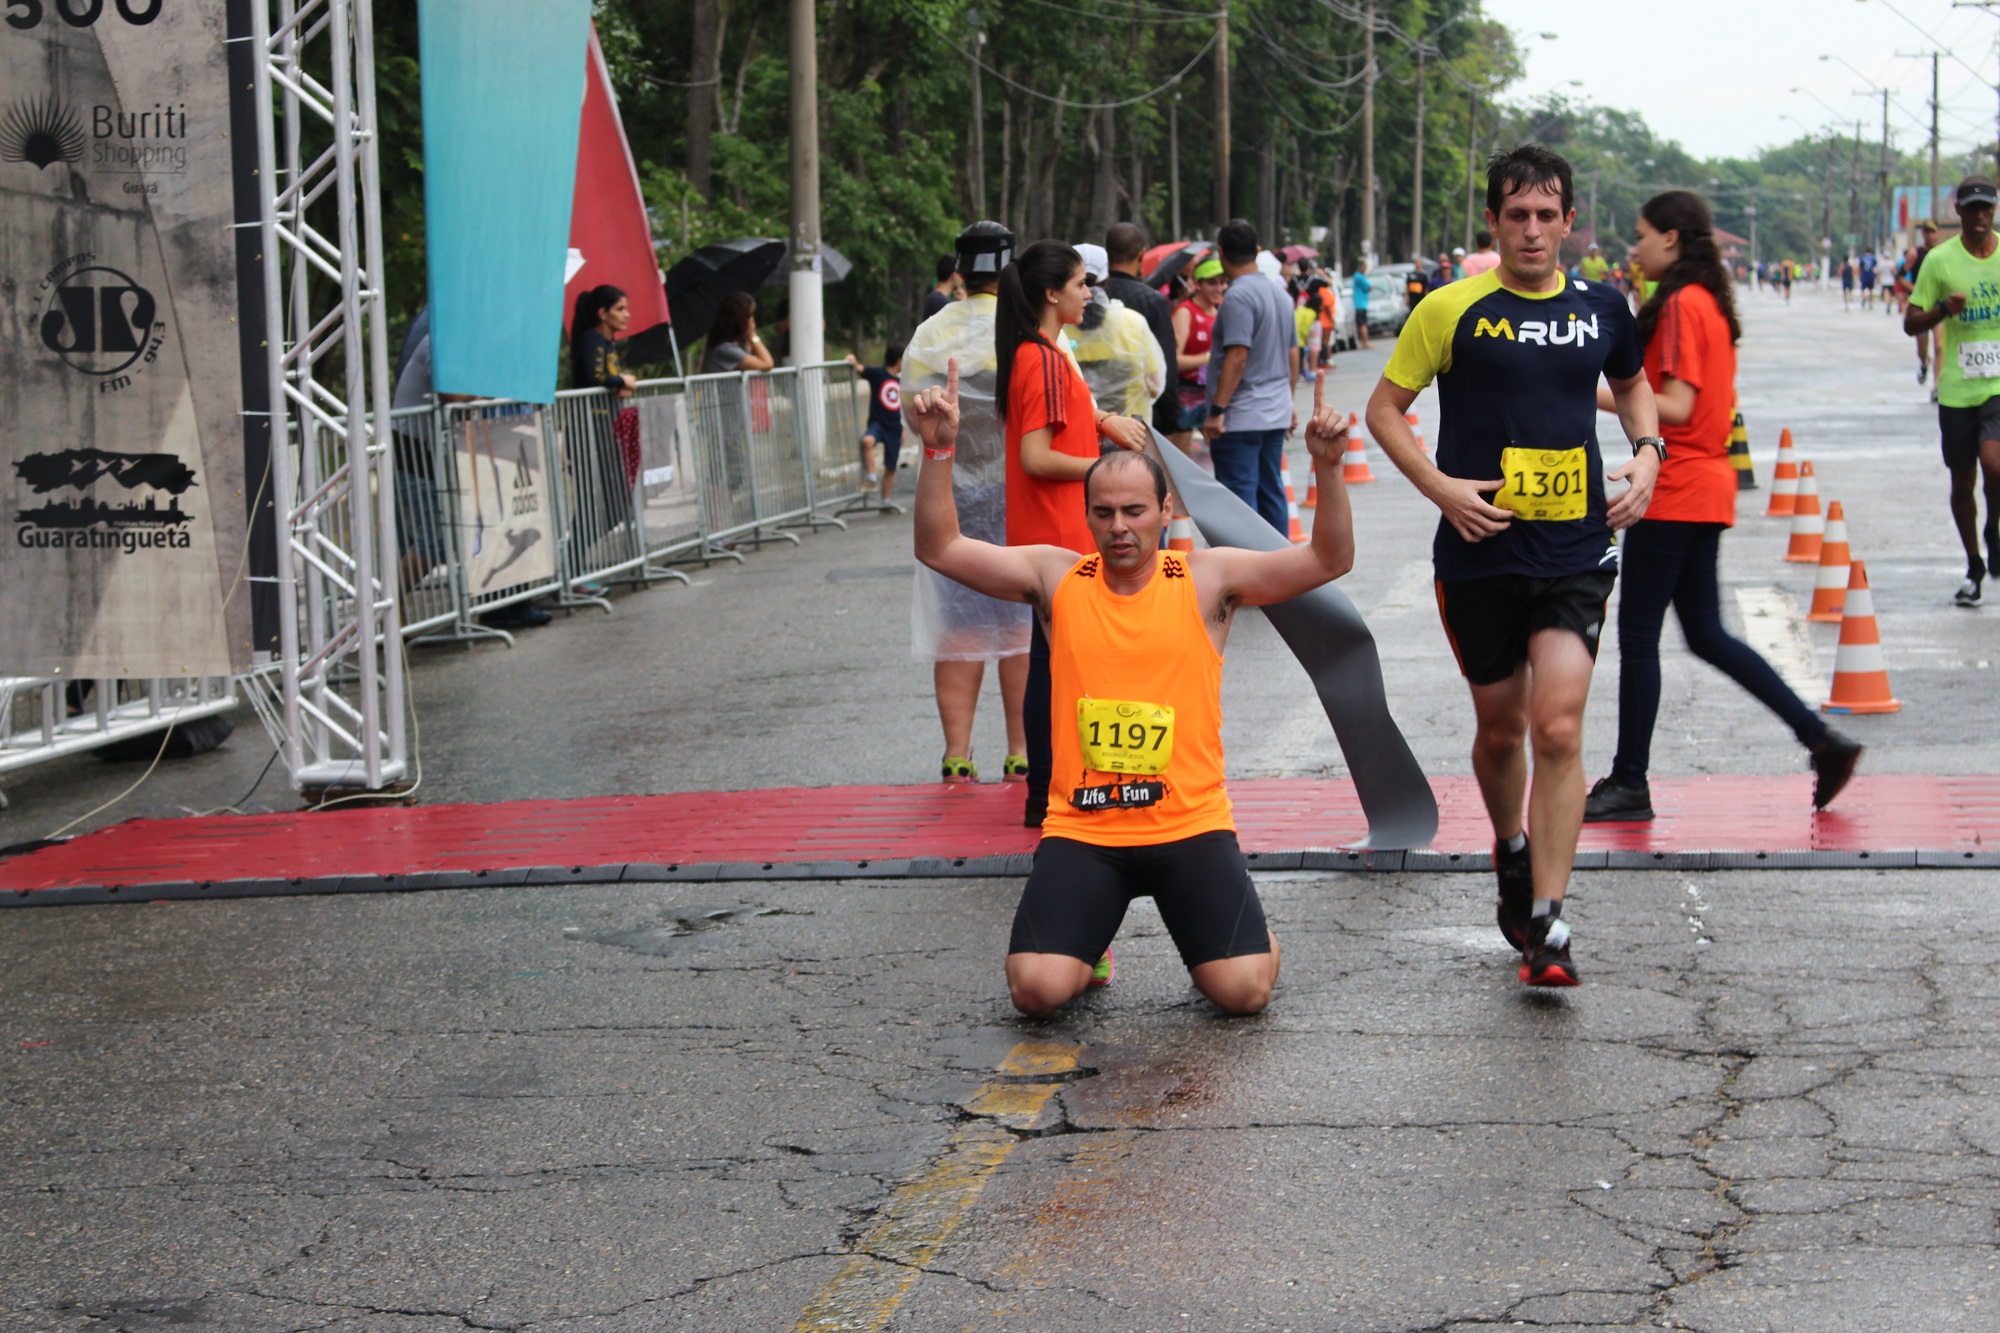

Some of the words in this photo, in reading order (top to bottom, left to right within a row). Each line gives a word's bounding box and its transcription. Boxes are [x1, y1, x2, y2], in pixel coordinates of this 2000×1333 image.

[93, 103, 185, 138] Buriti
[93, 142, 185, 169] Shopping
[1513, 469, 1582, 497] 1301
[17, 524, 190, 554] Guaratinguetá
[1089, 721, 1168, 751] 1197
[1082, 788, 1106, 805] Life
[1109, 785, 1120, 801] 4
[1122, 785, 1149, 801] Fun
